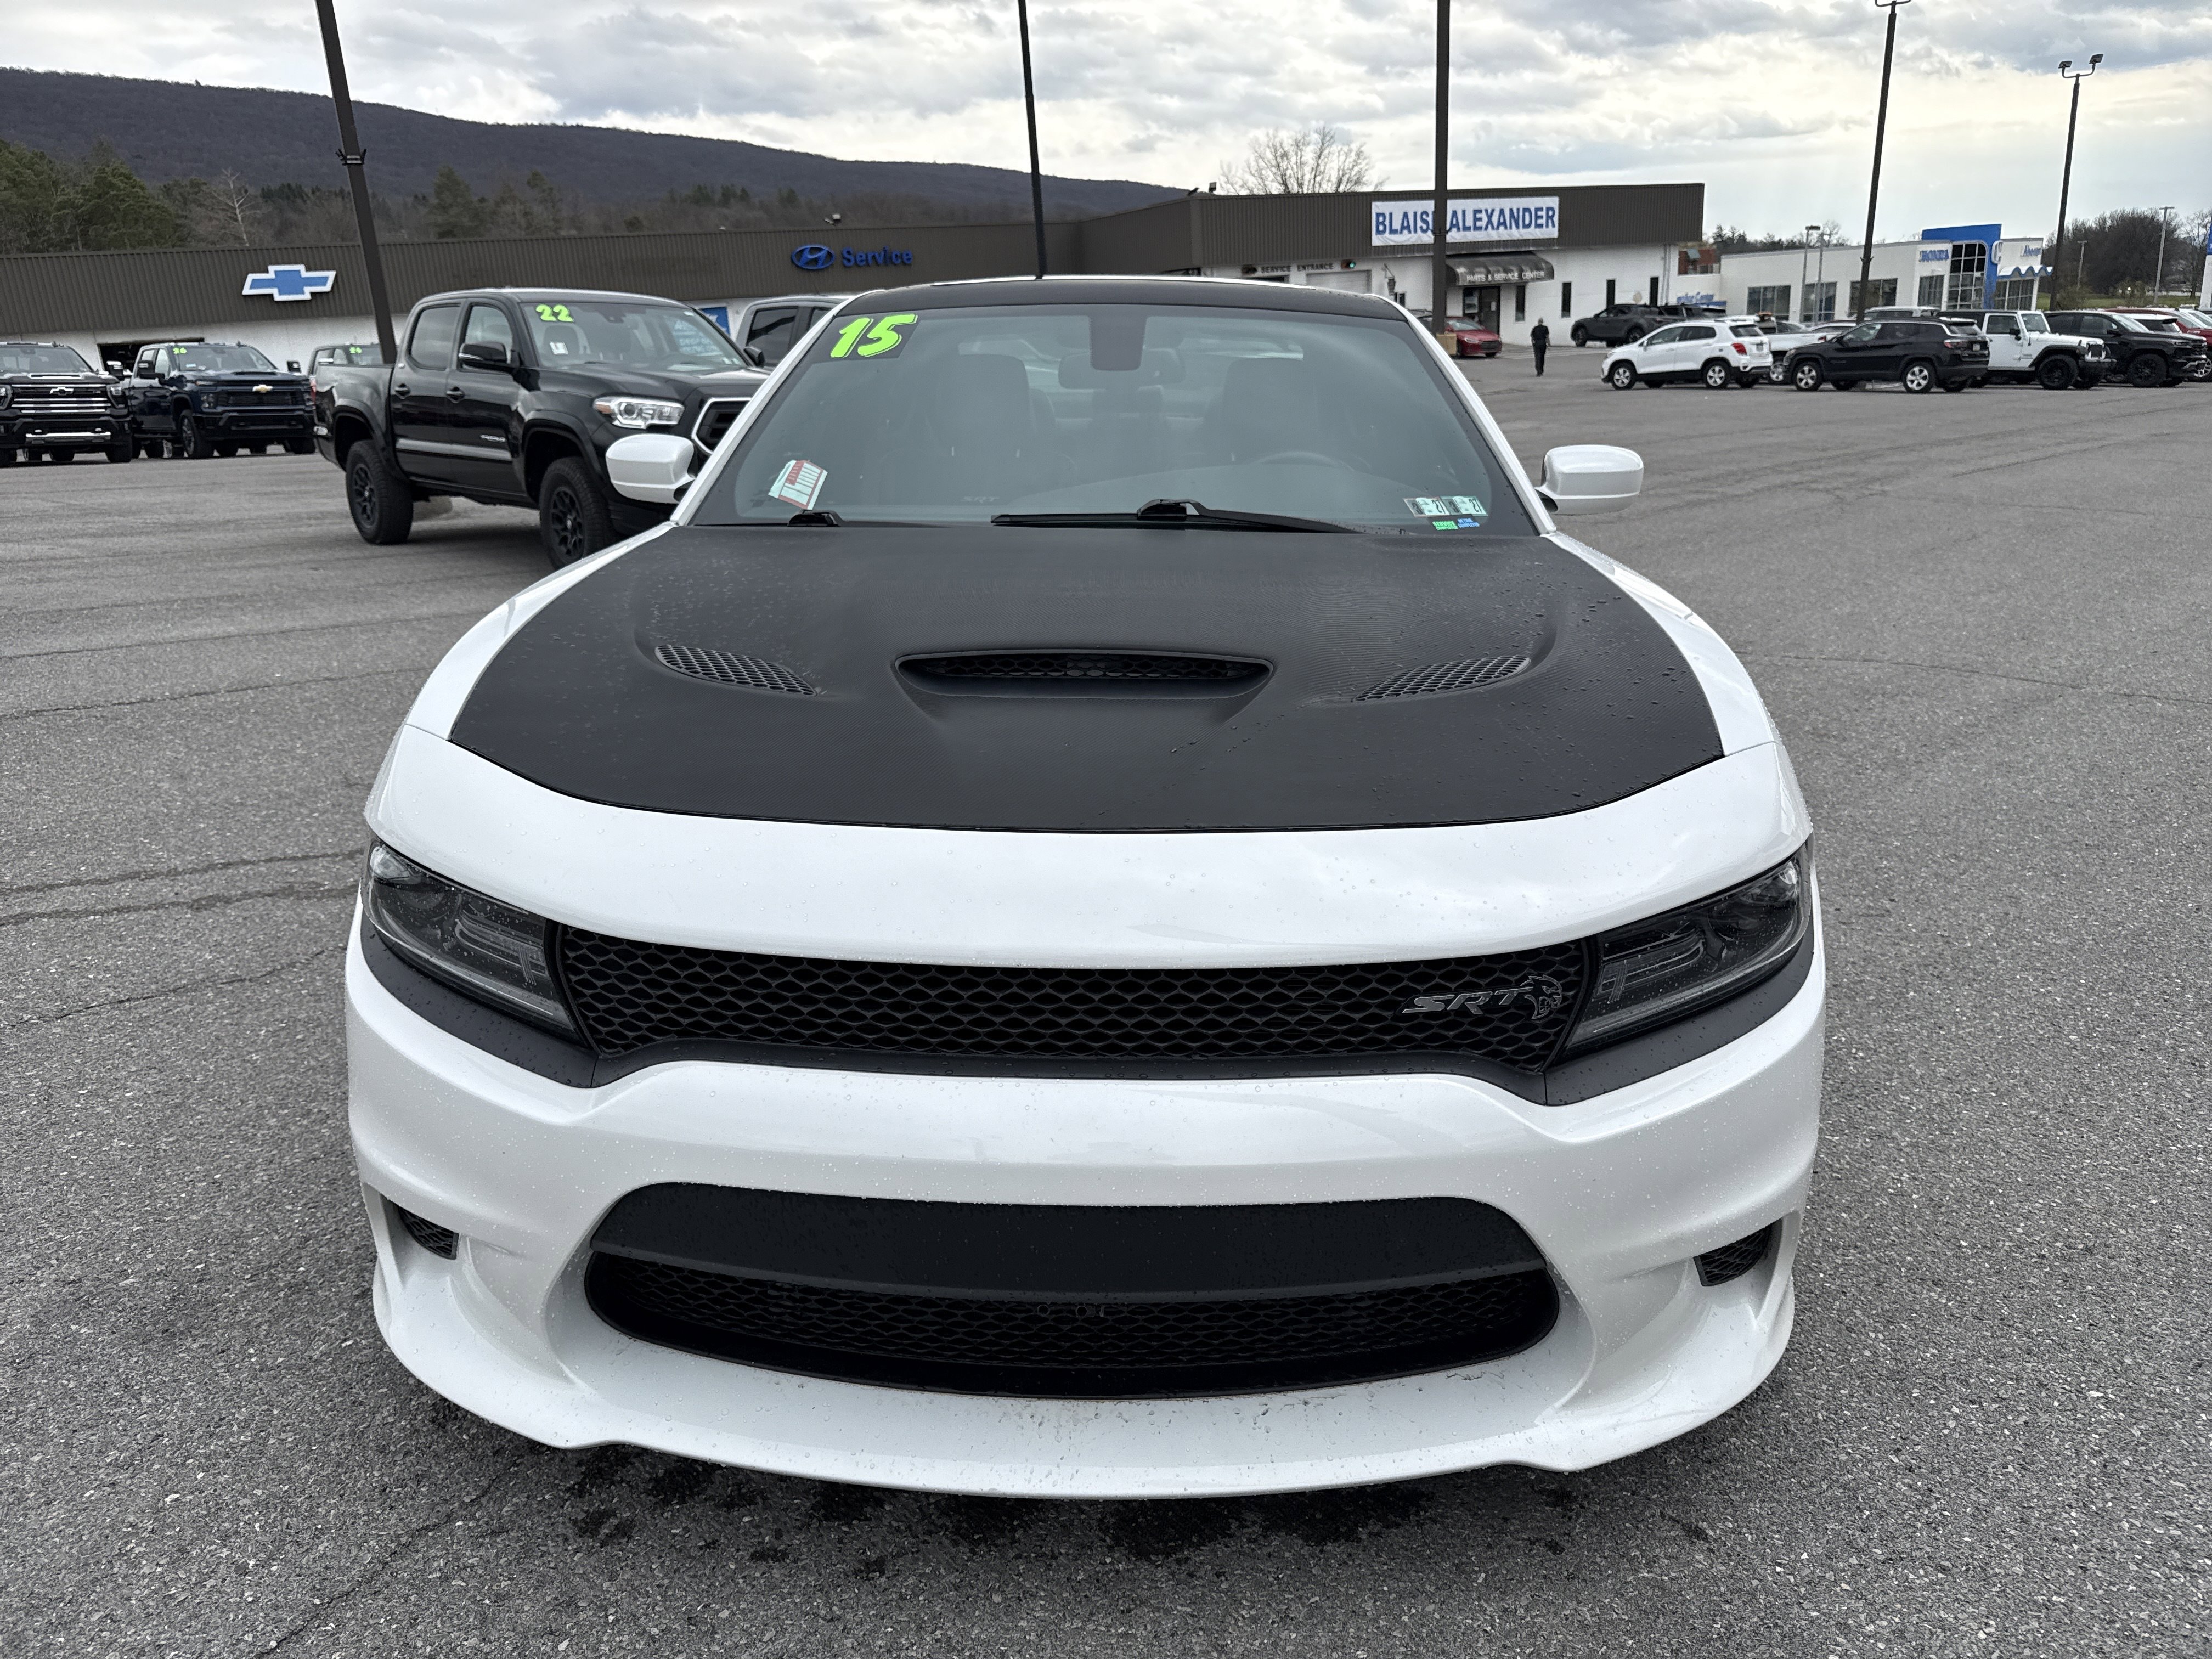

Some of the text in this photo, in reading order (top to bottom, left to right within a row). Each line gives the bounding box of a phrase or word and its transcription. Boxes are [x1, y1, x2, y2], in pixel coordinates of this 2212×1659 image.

[1375, 206, 1556, 235] BLAIS ALEXANDER
[841, 246, 913, 267] Service
[1494, 272, 1519, 280] SERVICE
[1522, 270, 1544, 279] CENTER
[535, 304, 574, 323] 22
[831, 313, 918, 358] 15
[1431, 499, 1446, 514] 27
[1468, 499, 1482, 513] 27
[1402, 987, 1533, 1014] SRT
